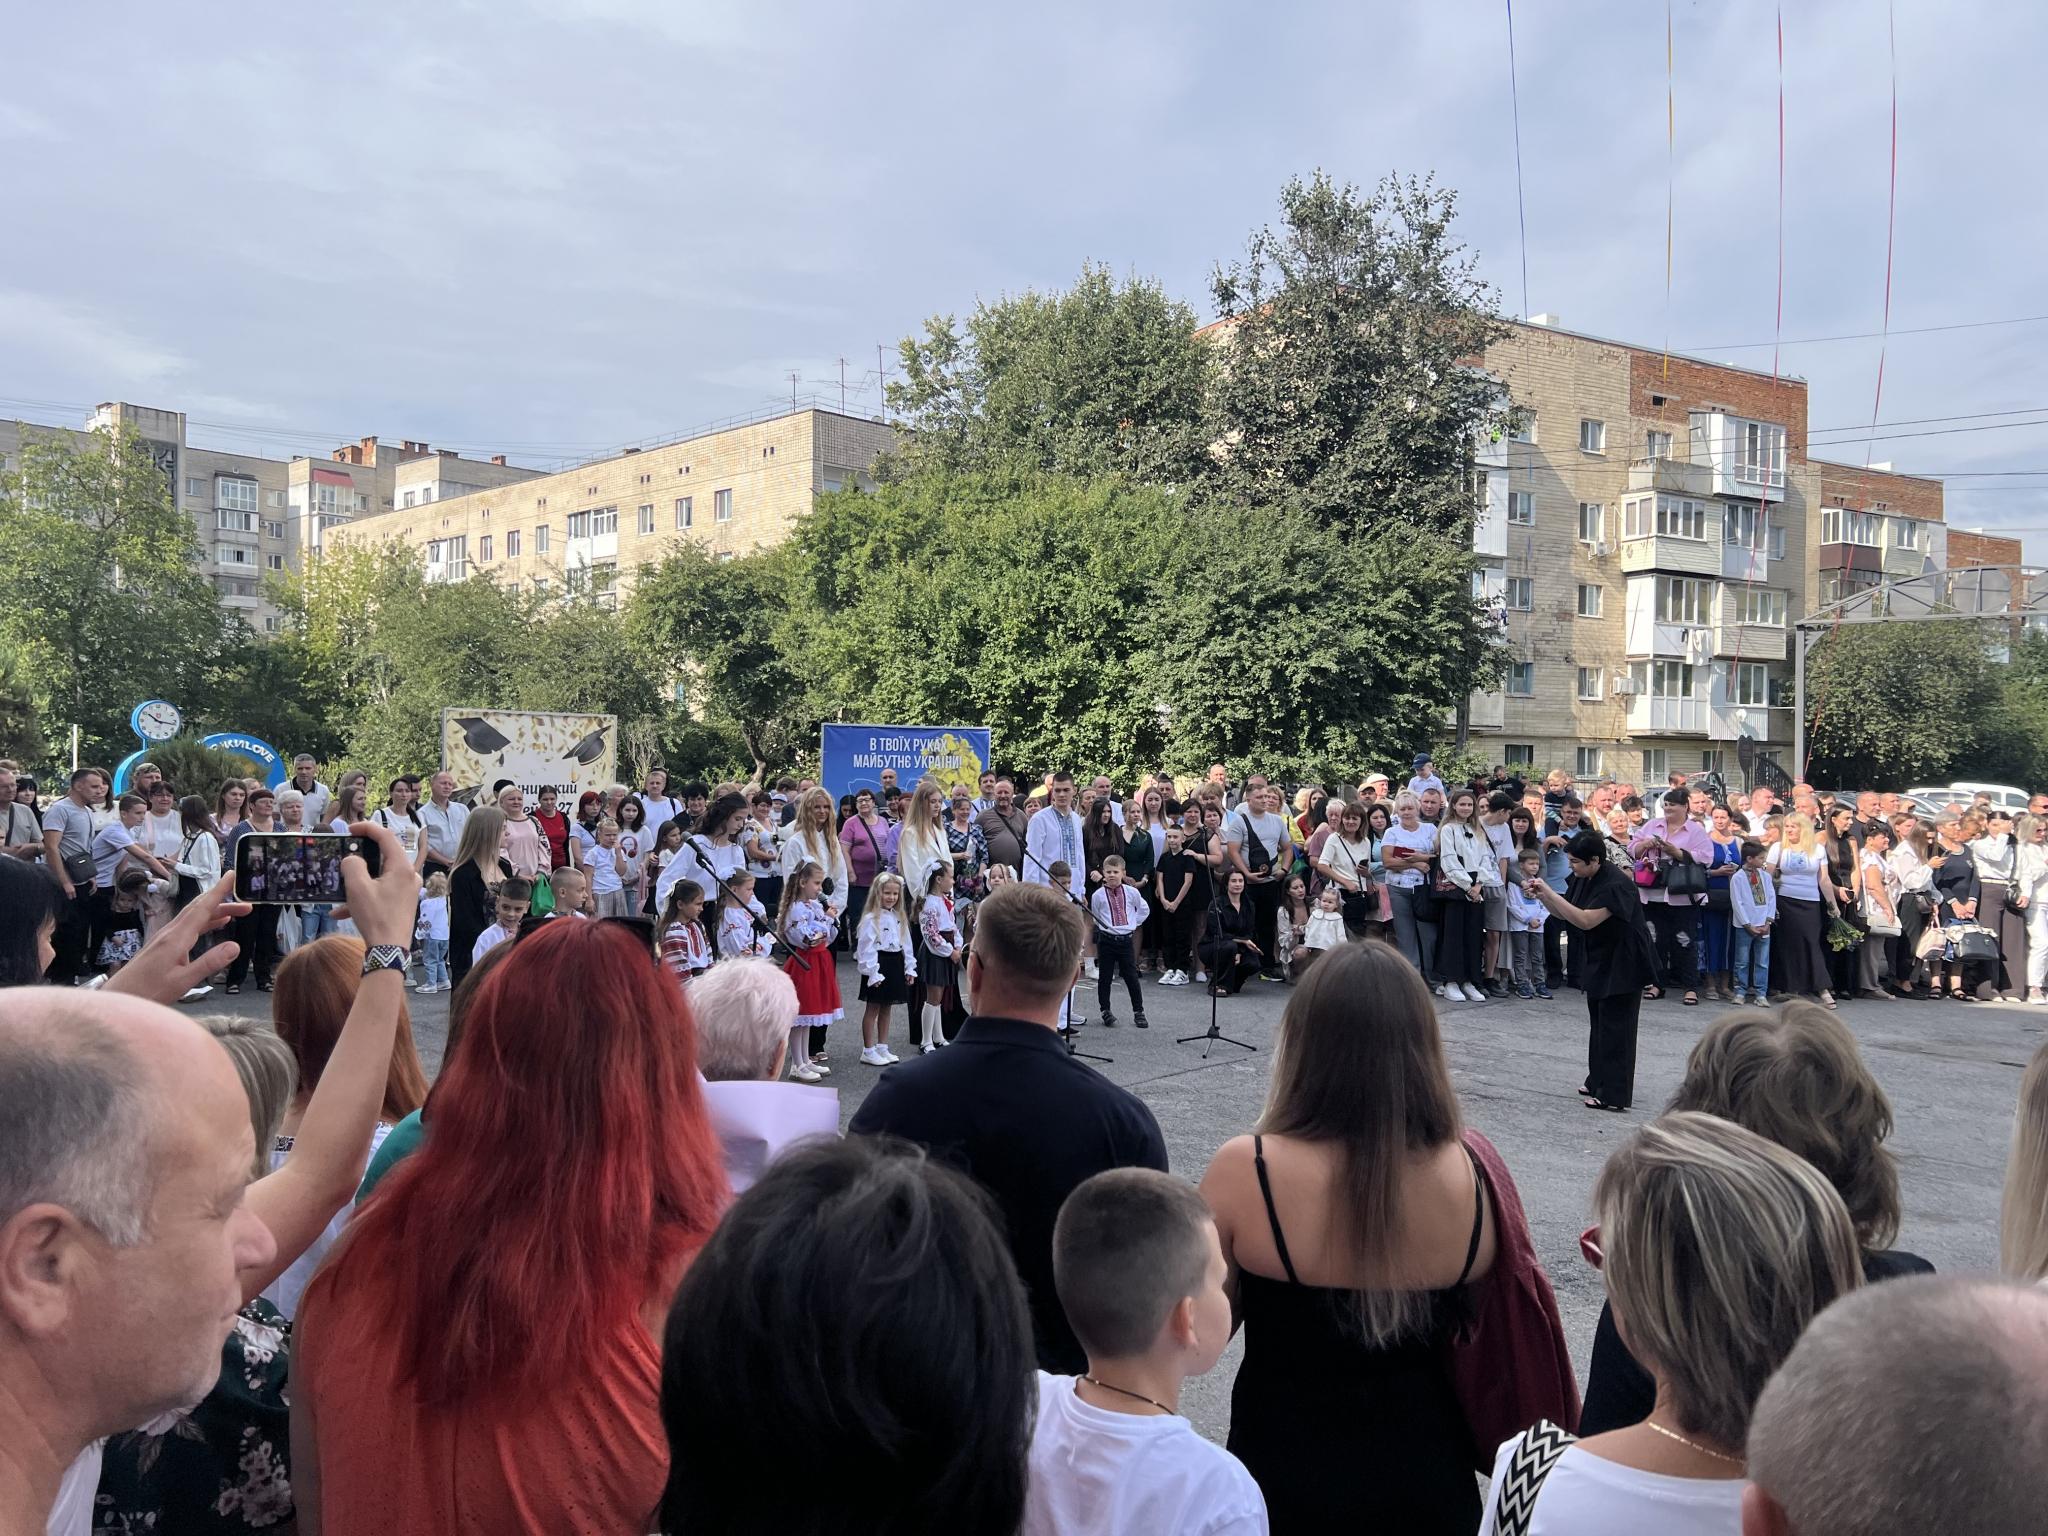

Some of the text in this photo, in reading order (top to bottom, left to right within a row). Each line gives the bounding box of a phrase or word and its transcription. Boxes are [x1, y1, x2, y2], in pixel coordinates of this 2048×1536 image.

[870, 735, 947, 751] В ТВОЇХ РУКАХ
[853, 753, 962, 768] МАЙБУТНЄ УКРАЇНИ!
